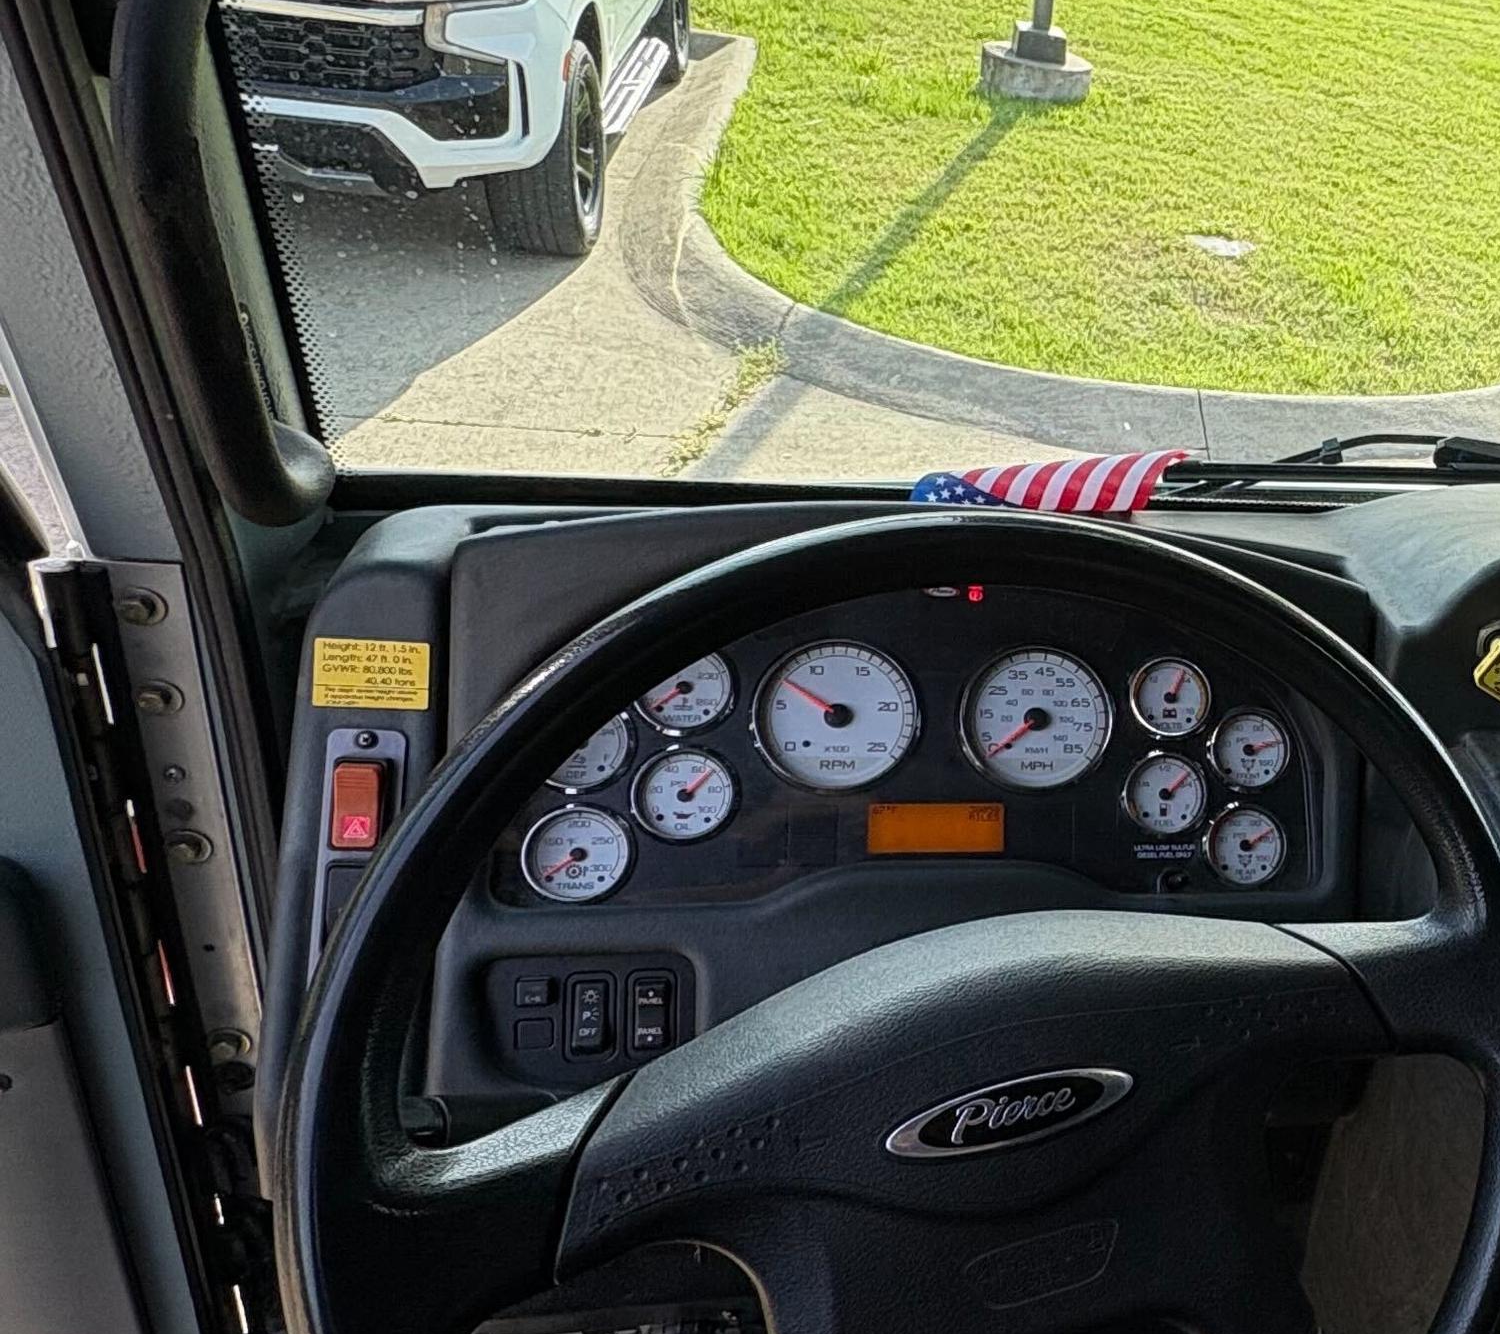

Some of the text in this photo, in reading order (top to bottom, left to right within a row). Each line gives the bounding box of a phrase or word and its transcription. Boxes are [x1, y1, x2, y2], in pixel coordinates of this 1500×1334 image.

[366, 654, 378, 663] 47
[809, 665, 824, 675] 10
[855, 666, 871, 676] 15
[1009, 670, 1028, 681] 35
[1035, 666, 1055, 677] 45
[1056, 677, 1075, 688] 55
[988, 685, 1008, 696] 25
[775, 700, 787, 711] 5
[878, 702, 898, 712] 20
[1071, 697, 1090, 708] 65
[663, 713, 702, 723] WATER
[979, 709, 994, 719] 15
[1074, 722, 1093, 733] 75
[981, 732, 992, 743] 5
[866, 742, 888, 753] 25
[1063, 744, 1084, 755] 85
[819, 759, 856, 771] RPM
[1020, 760, 1053, 771] MPH
[556, 881, 595, 891] TRANS
[578, 1027, 598, 1037] OFF
[951, 1083, 1077, 1147] Pierce
